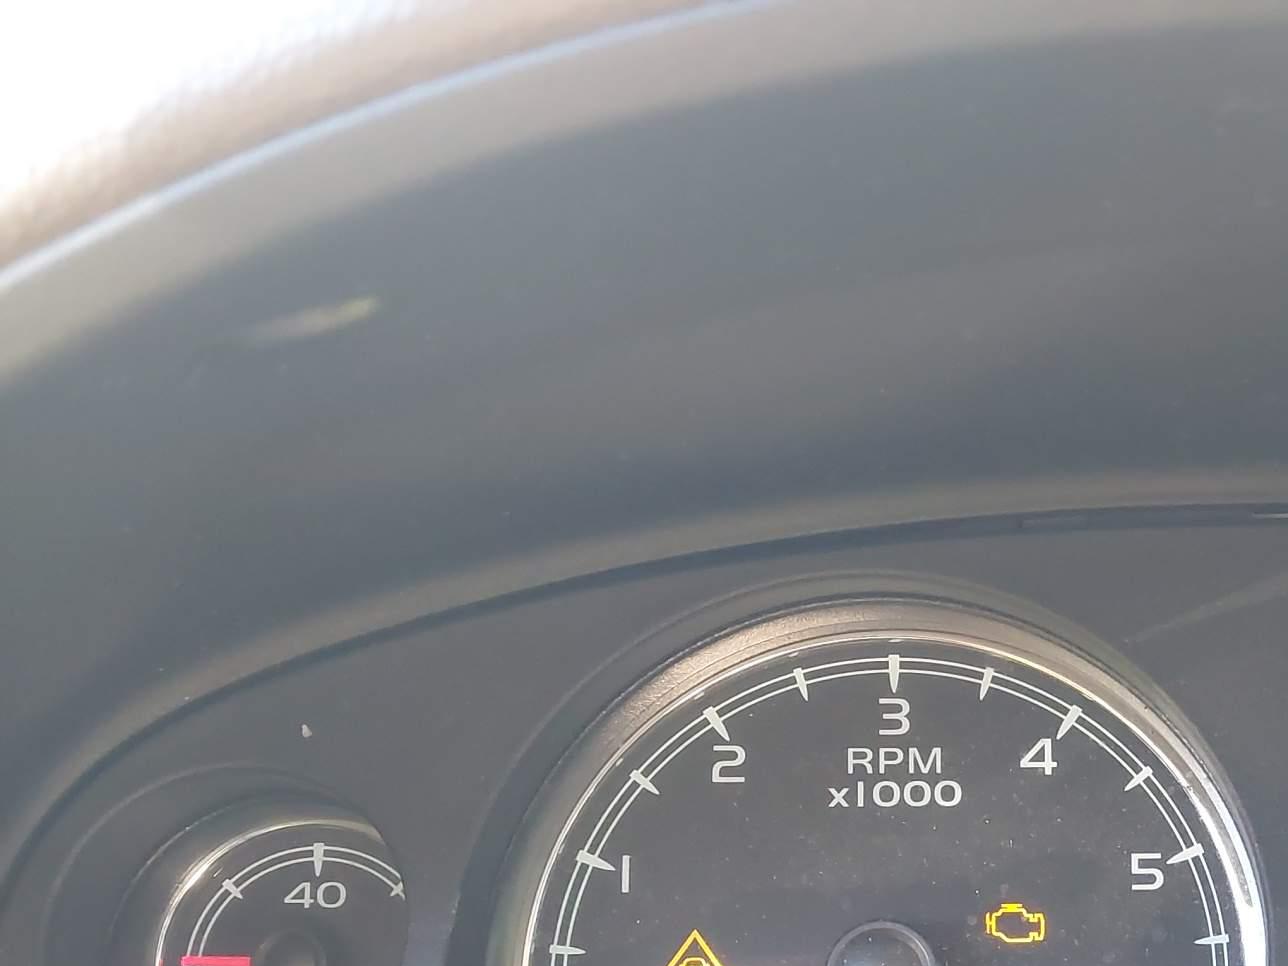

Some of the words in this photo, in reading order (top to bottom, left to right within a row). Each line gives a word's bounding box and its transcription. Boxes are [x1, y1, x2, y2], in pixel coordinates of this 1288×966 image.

[879, 698, 910, 735] 3
[712, 746, 746, 782] 2
[847, 748, 942, 774] RPM
[1021, 737, 1056, 775] 4
[828, 780, 962, 807] x1000
[621, 854, 630, 893] 1
[1131, 853, 1163, 890] 5
[284, 881, 347, 909] 40
